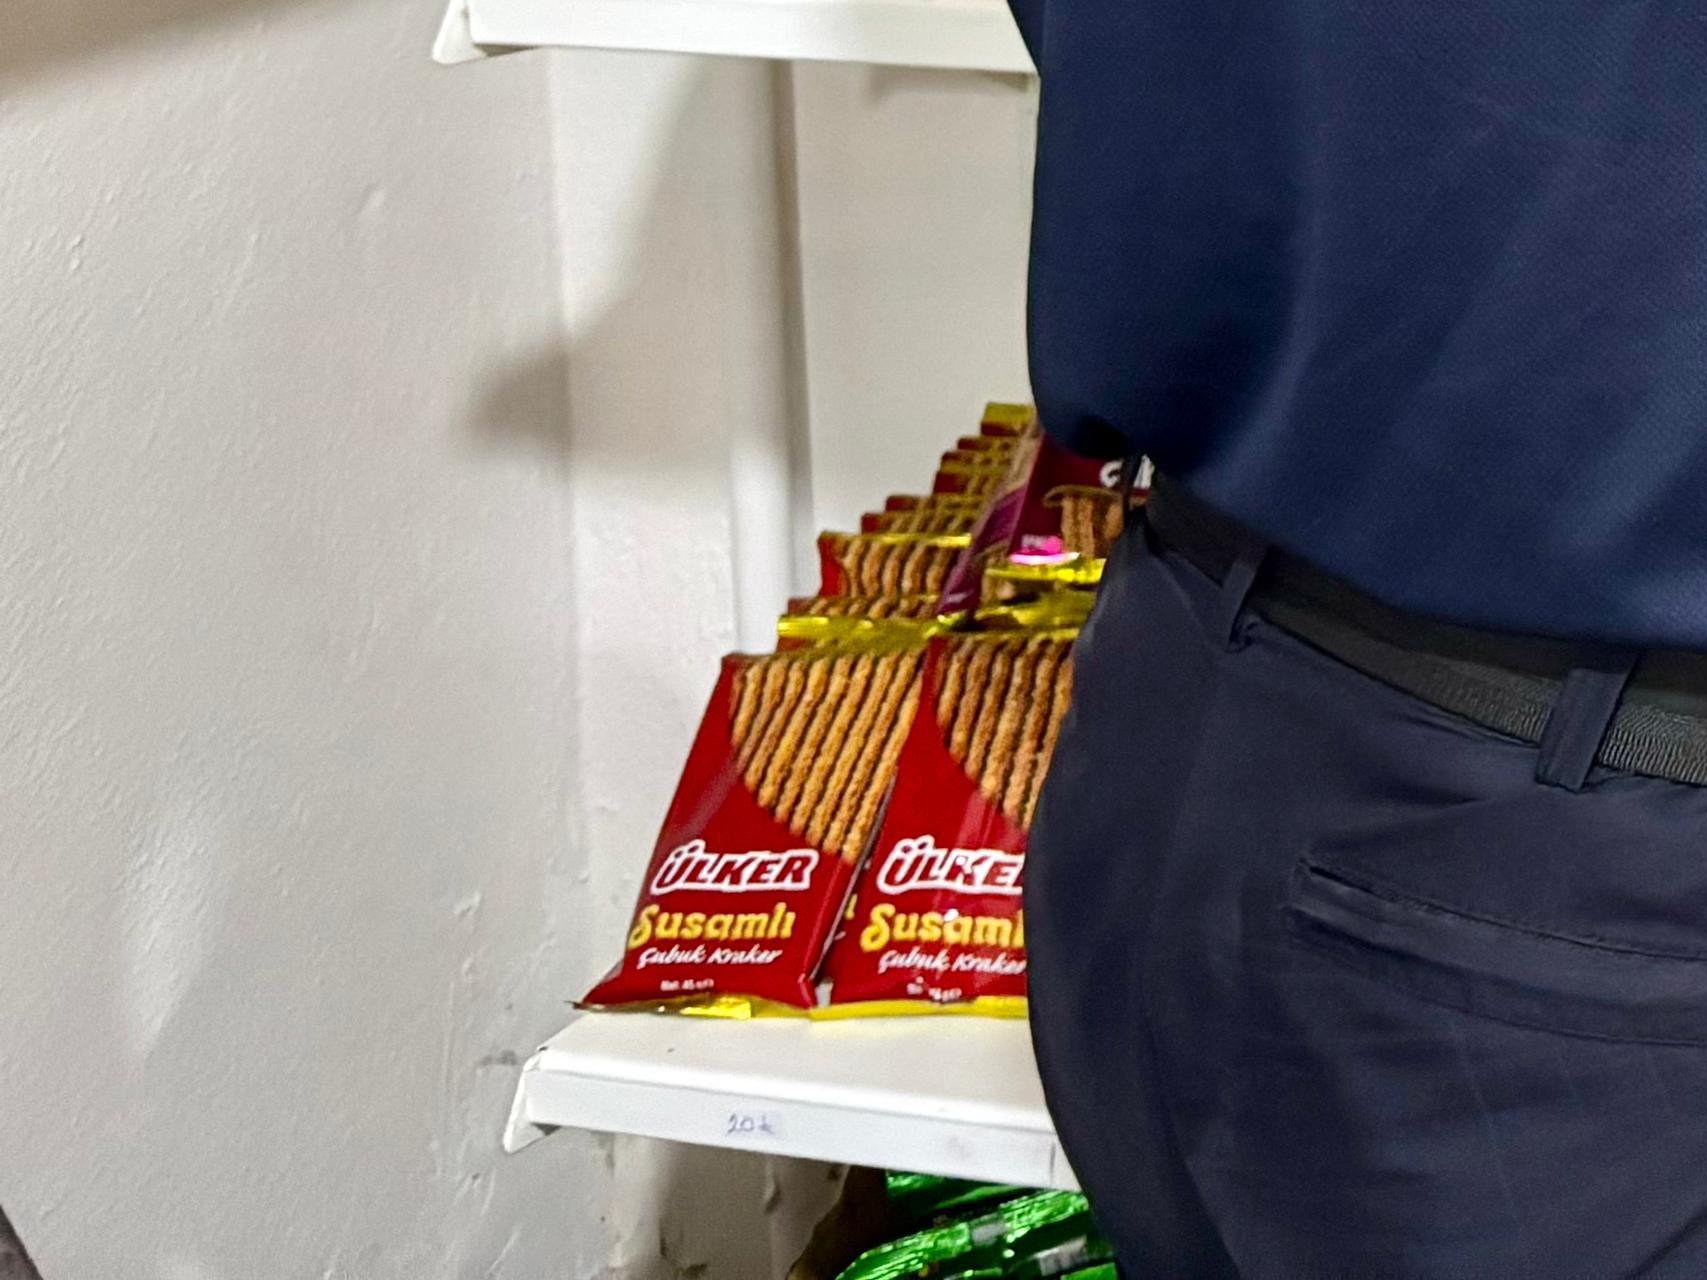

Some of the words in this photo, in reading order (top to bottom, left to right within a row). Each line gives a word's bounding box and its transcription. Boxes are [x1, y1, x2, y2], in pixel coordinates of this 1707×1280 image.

[652, 840, 820, 893] ÜLKER
[627, 903, 795, 951] Susamlı
[707, 946, 783, 967] Kraker
